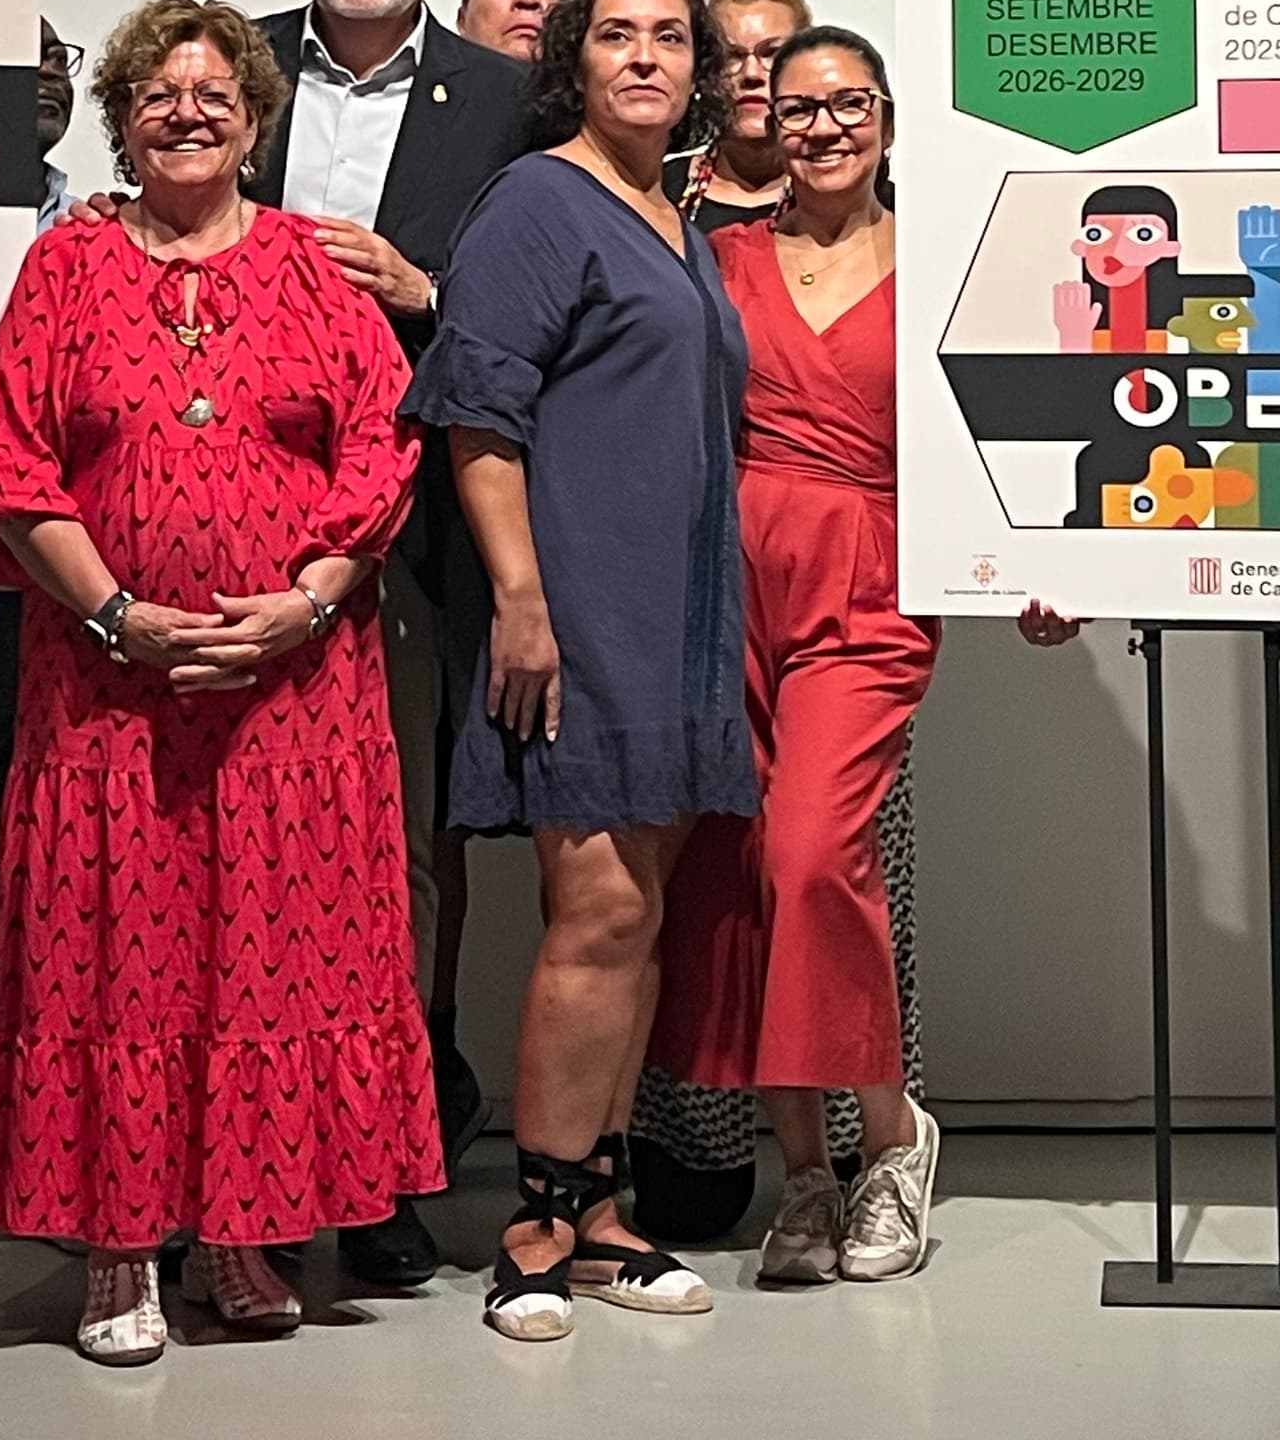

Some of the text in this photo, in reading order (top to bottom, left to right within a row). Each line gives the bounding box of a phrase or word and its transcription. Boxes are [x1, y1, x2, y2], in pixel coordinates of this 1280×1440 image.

[1224, 5, 1258, 27] de
[987, 31, 1158, 57] DESEMBRE
[998, 68, 1145, 93] 2026-2029
[1230, 580, 1254, 597] de
